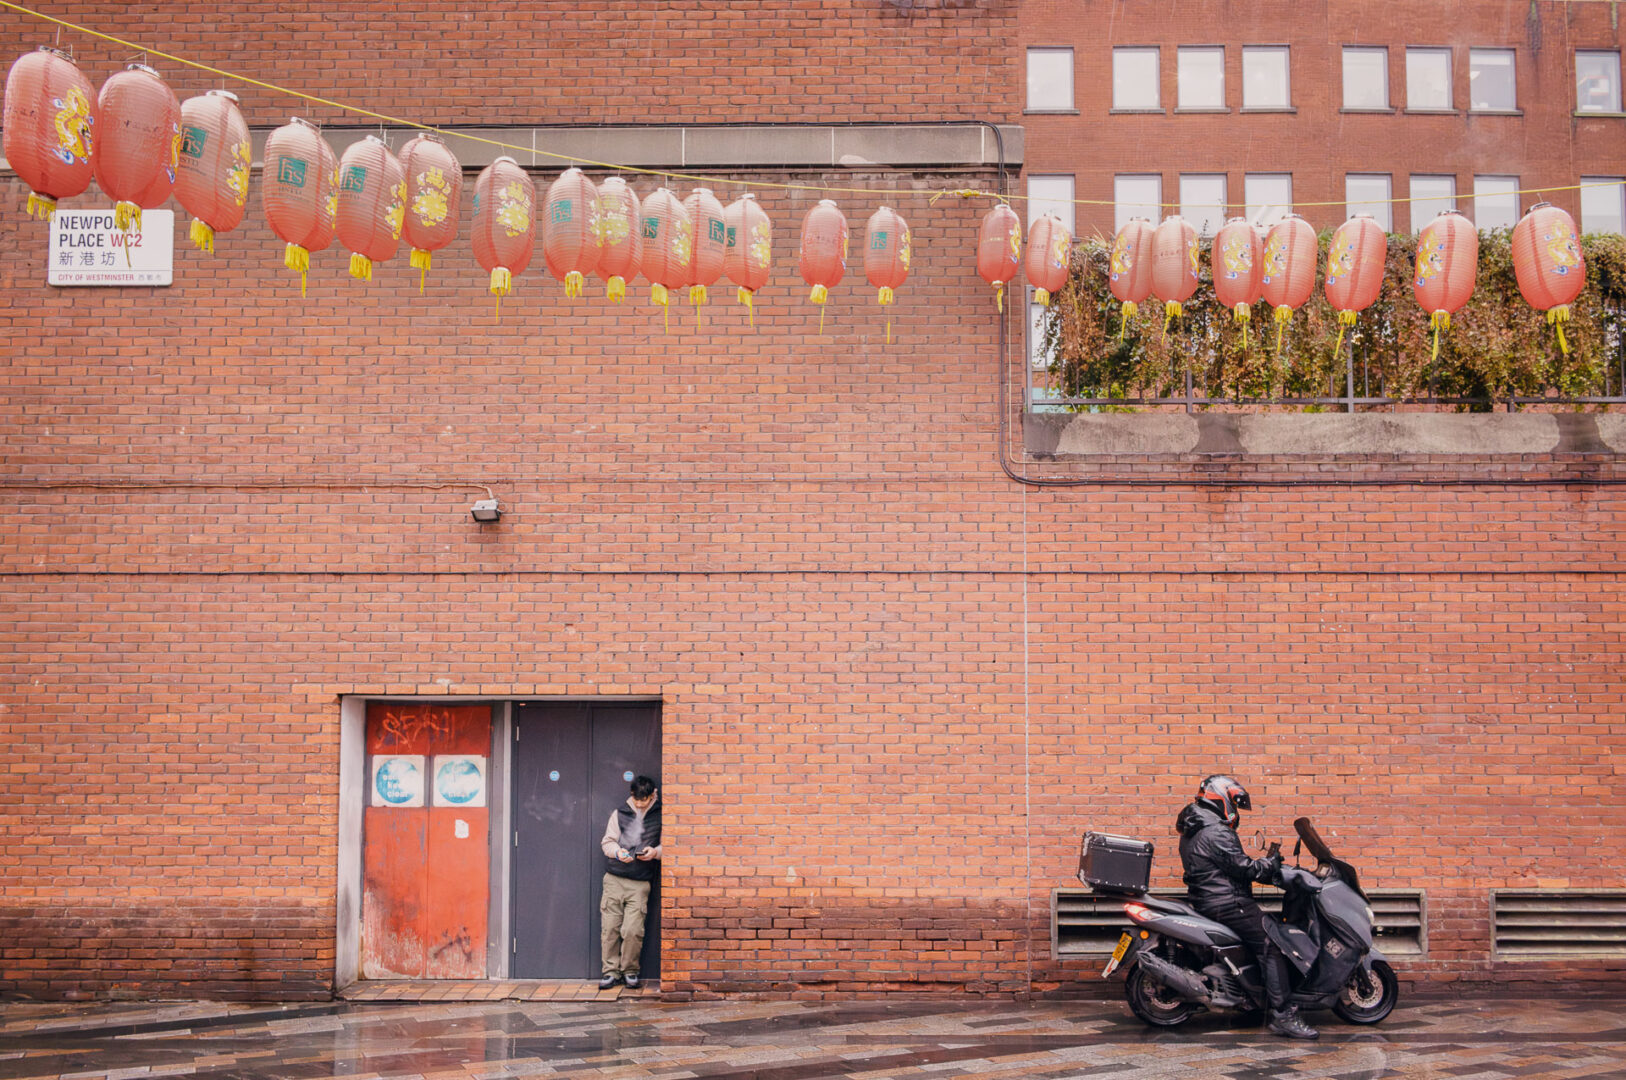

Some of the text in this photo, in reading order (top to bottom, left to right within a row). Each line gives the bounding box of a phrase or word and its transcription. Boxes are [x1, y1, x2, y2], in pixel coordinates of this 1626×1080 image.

[60, 216, 118, 229] NEWPO
[59, 233, 142, 247] PLACE WC2
[59, 251, 116, 266] 新港坊
